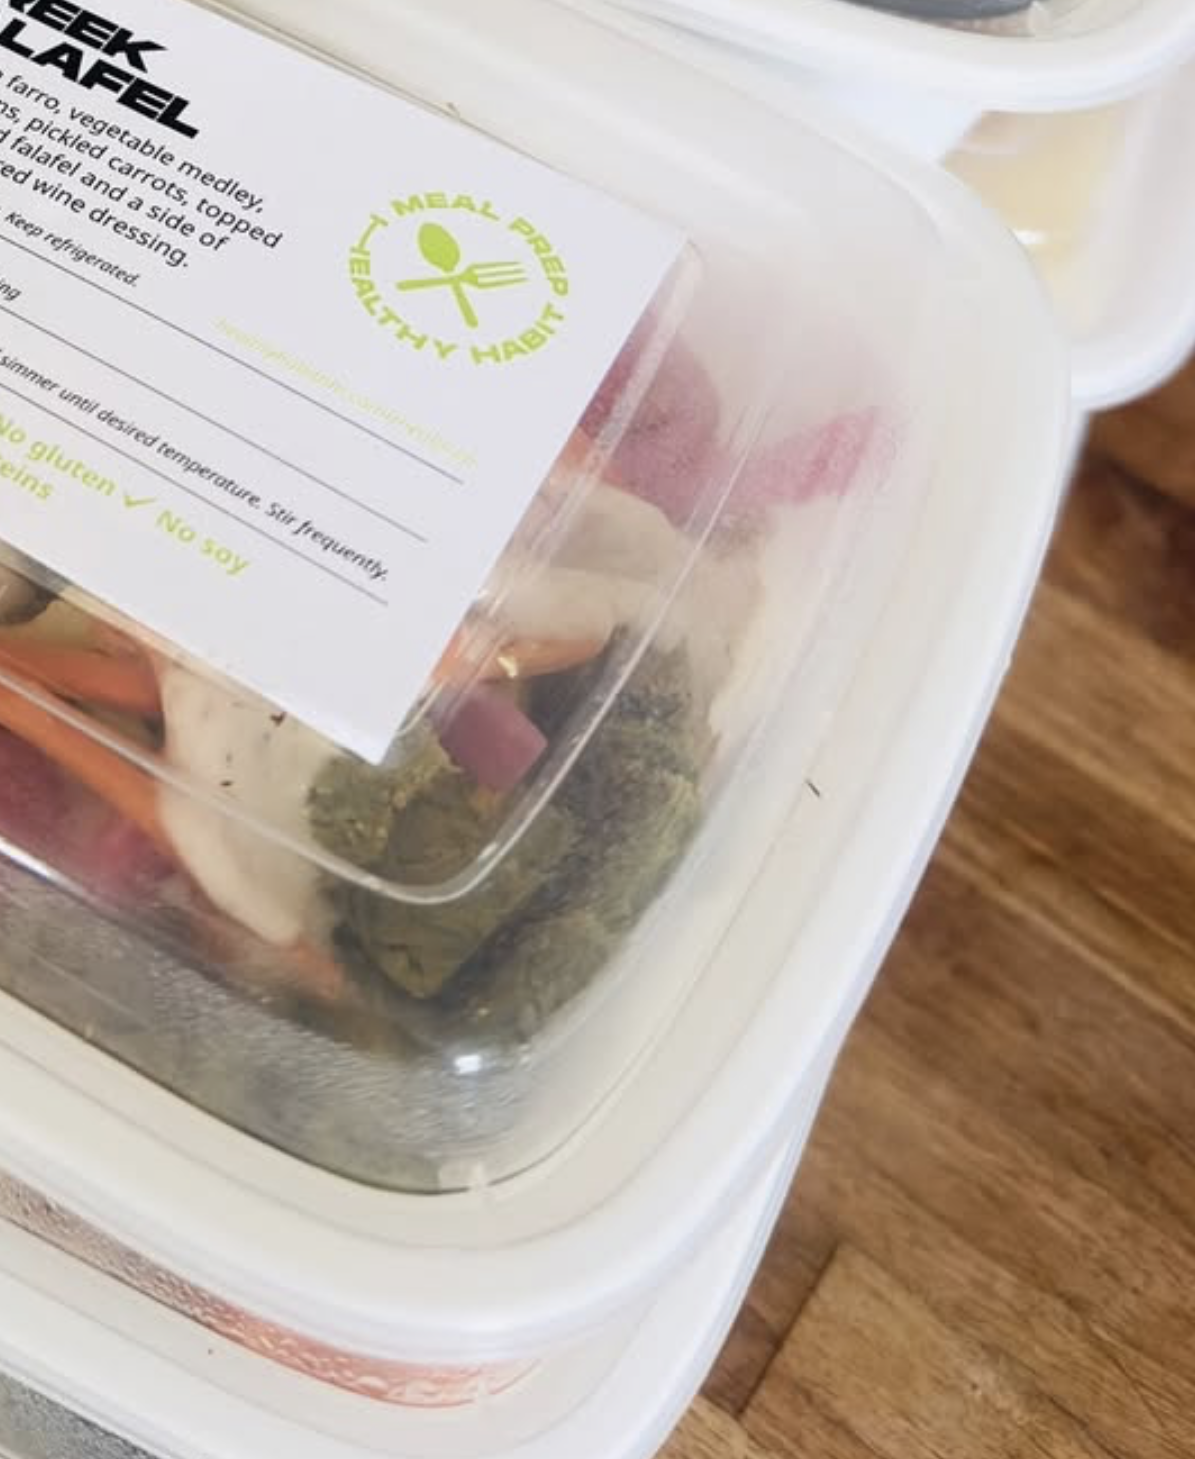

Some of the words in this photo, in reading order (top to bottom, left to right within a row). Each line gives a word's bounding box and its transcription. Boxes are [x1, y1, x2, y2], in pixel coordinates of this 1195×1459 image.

[5, 74, 61, 115] farro,
[69, 107, 175, 166] vegetable
[177, 160, 263, 214] medley,
[9, 135, 82, 177] falafel
[79, 172, 129, 202] and
[126, 196, 144, 212] a
[145, 205, 196, 238] side
[198, 232, 231, 251] of
[23, 117, 109, 160] pickled
[107, 156, 188, 207] carrots,
[196, 198, 283, 249] topped
[4, 211, 44, 237] Keep
[43, 232, 140, 287] refrigerated.
[32, 178, 86, 214] wine
[88, 208, 188, 268] dressing.
[391, 192, 500, 222] MEAL
[508, 216, 569, 296] PREP
[470, 303, 565, 365] HABIT
[24, 440, 117, 497] gluten
[155, 509, 198, 544] No
[200, 537, 250, 577] soy
[58, 388, 101, 414] until
[96, 409, 161, 448] desired
[156, 442, 261, 509] temperature.
[264, 502, 297, 526] Stir
[292, 520, 389, 580] frequently.
